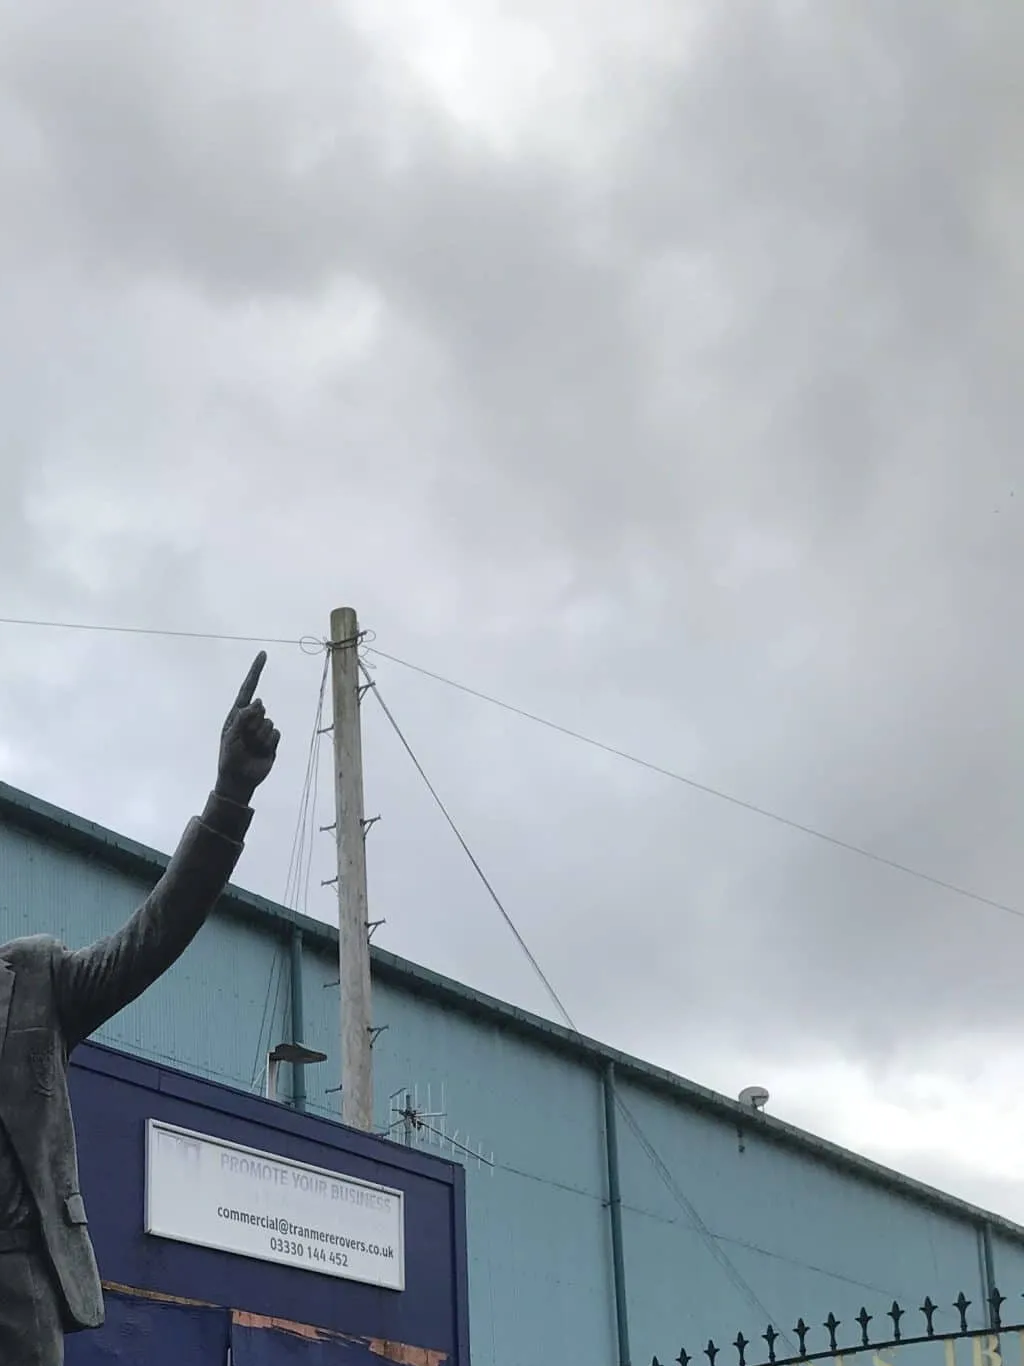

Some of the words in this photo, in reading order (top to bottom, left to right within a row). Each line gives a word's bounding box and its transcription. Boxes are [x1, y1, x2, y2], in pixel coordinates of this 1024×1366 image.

[220, 1152, 288, 1186] PROMOTE
[292, 1171, 328, 1197] YOUR
[331, 1183, 392, 1213] BUSINESS
[217, 1205, 394, 1259] commercial@tranmererovers.co.uk
[270, 1236, 304, 1257] 03330
[307, 1245, 326, 1262] 144
[329, 1251, 349, 1267] 452
